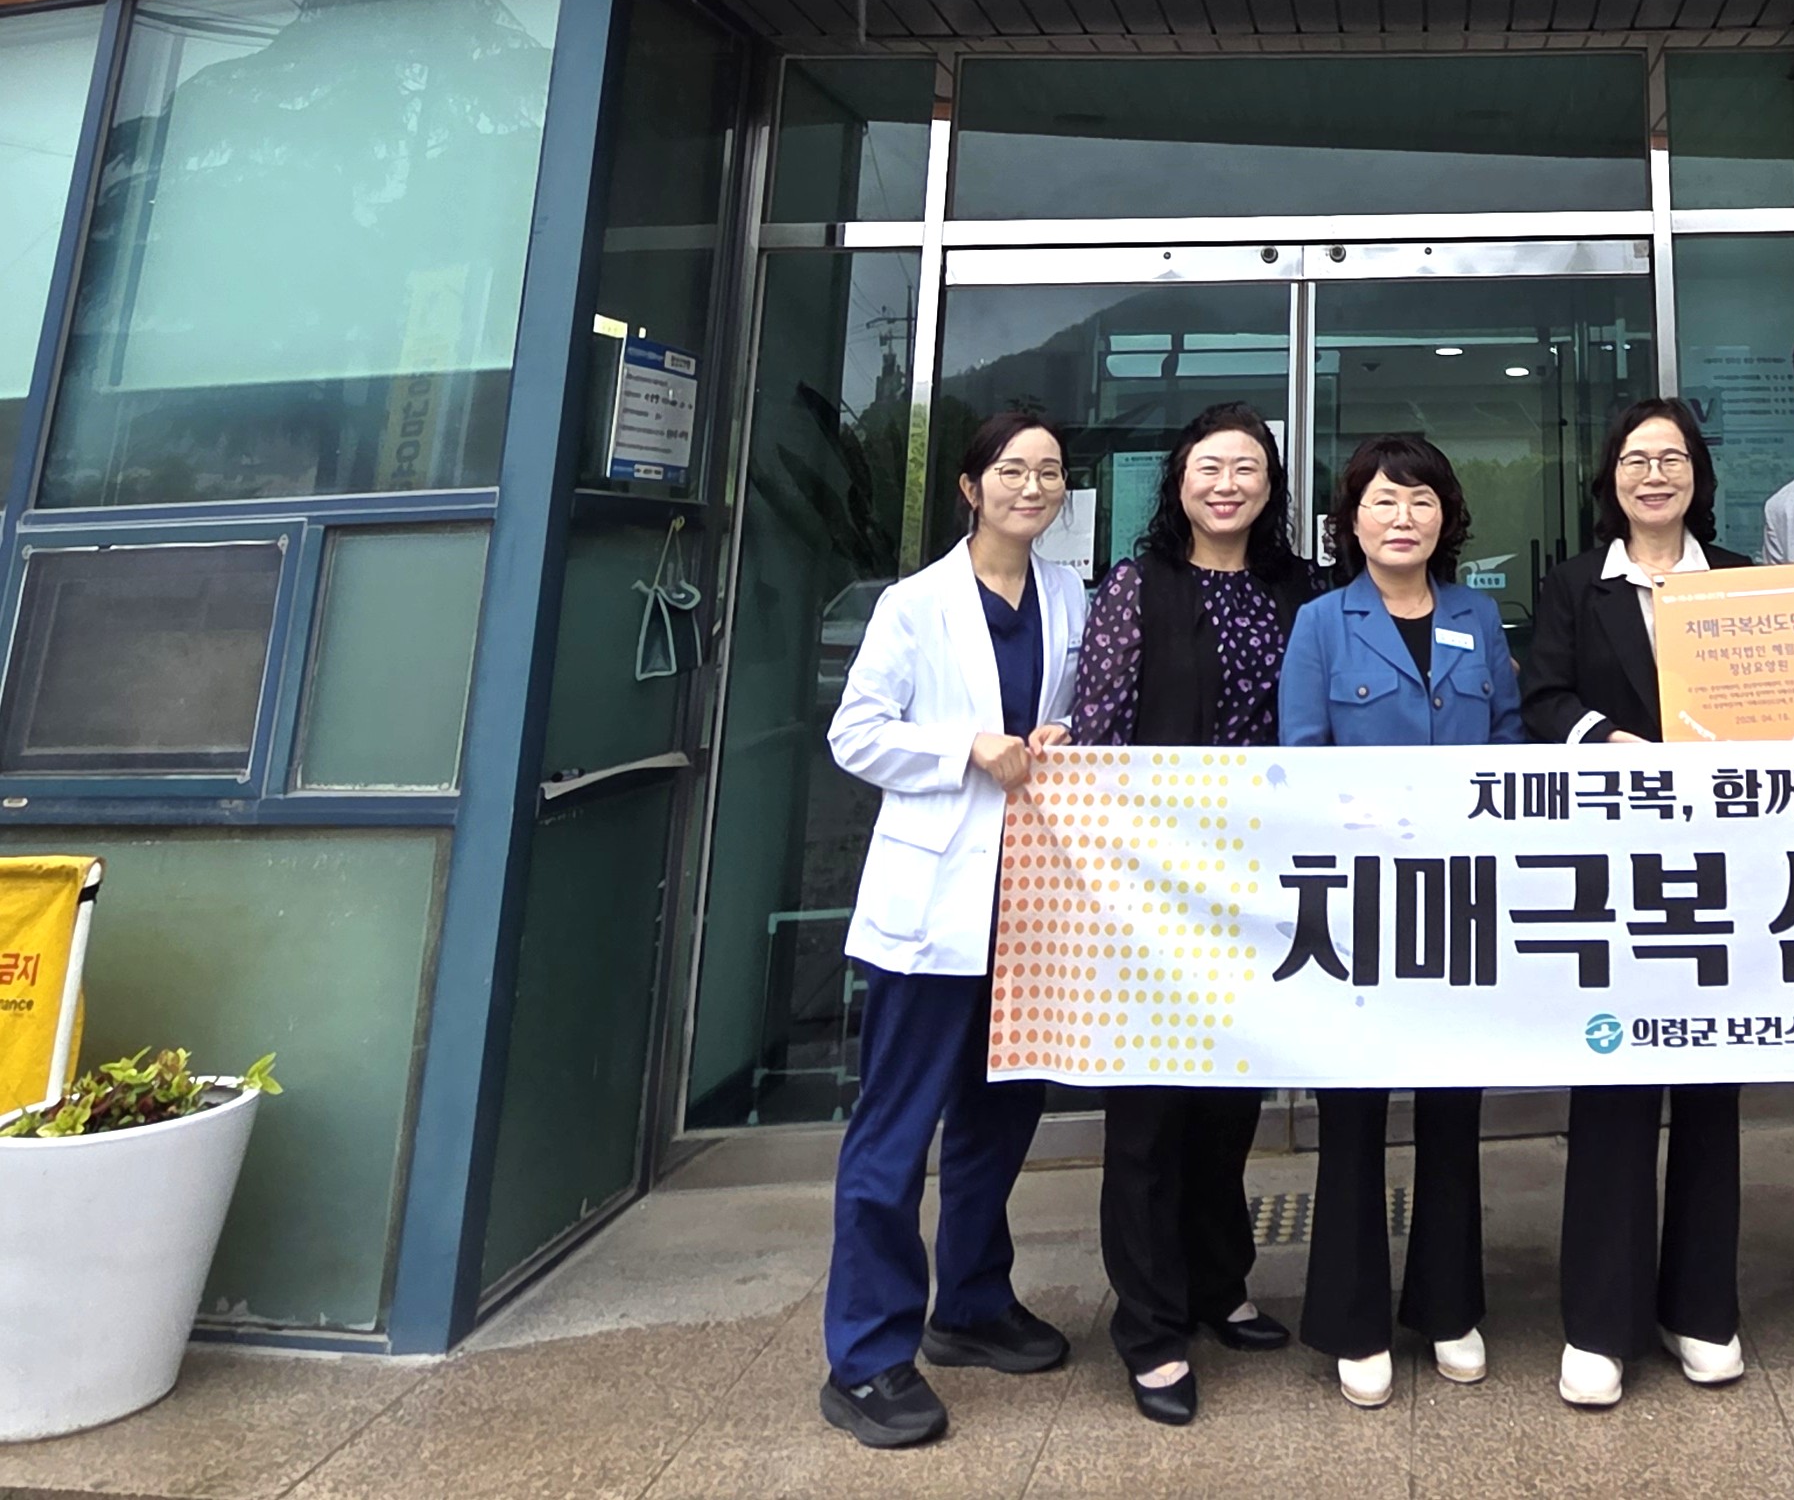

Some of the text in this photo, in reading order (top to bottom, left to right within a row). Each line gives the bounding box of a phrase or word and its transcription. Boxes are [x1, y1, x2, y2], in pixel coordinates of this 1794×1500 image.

[1729, 659, 1789, 677] 정남요양원
[1467, 770, 1693, 822] 치매극복,
[1272, 852, 1735, 988] 치매극복
[1632, 1018, 1718, 1048] 의령군
